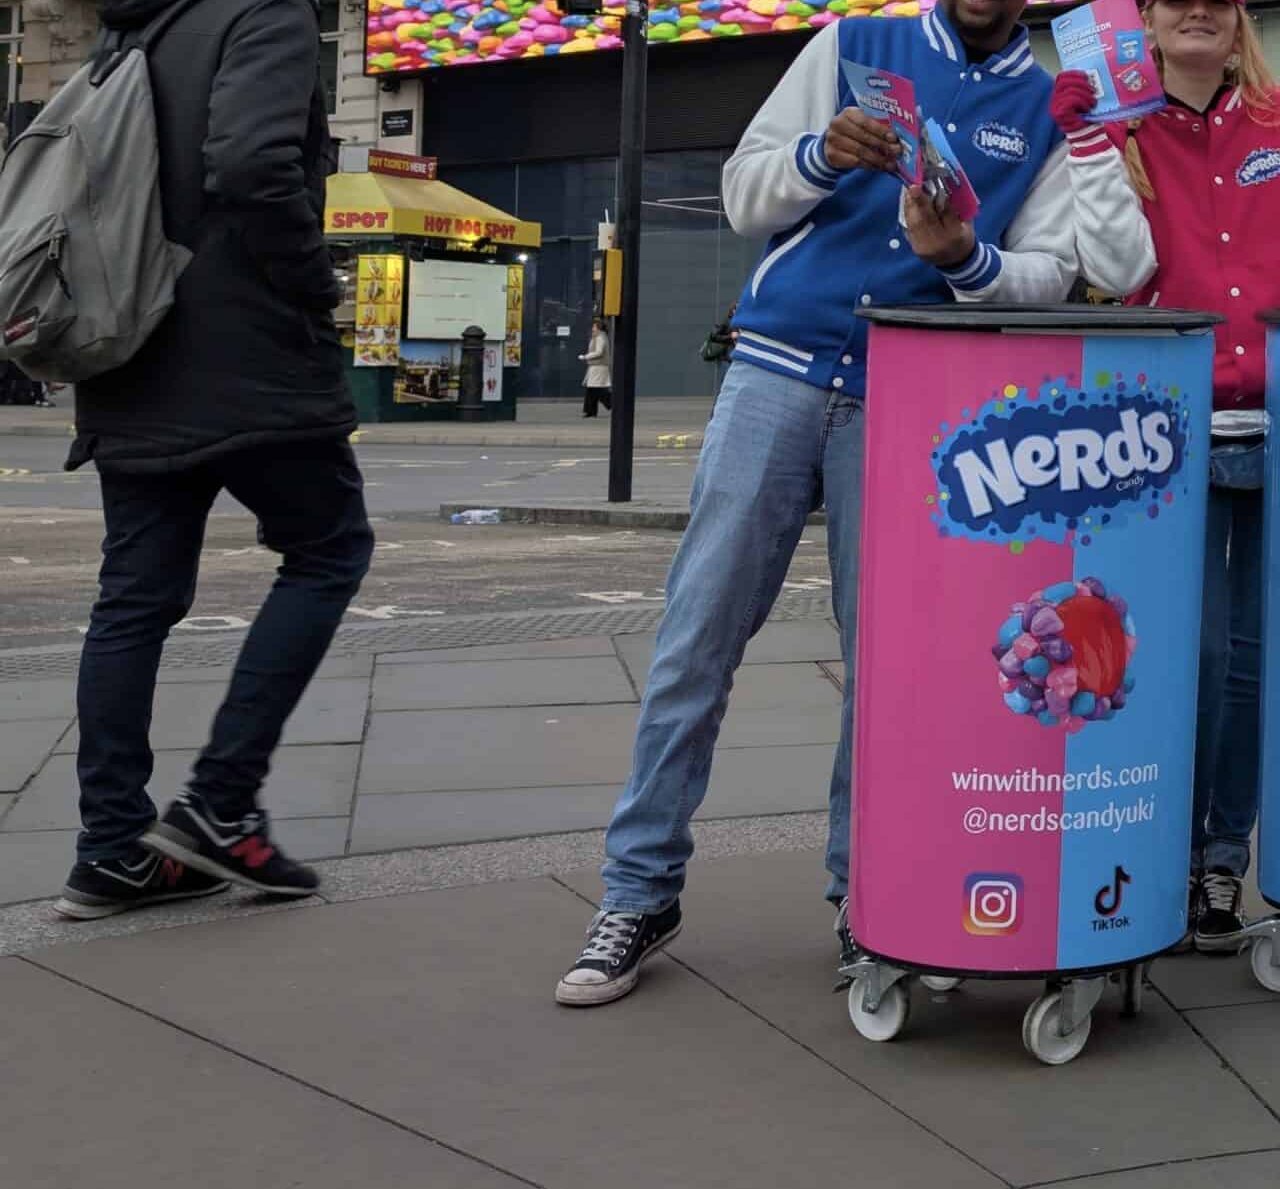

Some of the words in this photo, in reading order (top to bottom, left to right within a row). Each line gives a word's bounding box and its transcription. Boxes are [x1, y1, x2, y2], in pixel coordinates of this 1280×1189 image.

[410, 162, 427, 174] HERE
[331, 211, 389, 230] SPOT
[424, 214, 452, 234] HOT
[454, 218, 481, 237] DOG
[485, 221, 516, 241] SPOT
[1115, 474, 1146, 492] Candy
[951, 763, 1159, 793] winwithnerds.com
[963, 793, 1155, 834] @nerdscandyuki
[1091, 915, 1131, 933] TikTok
